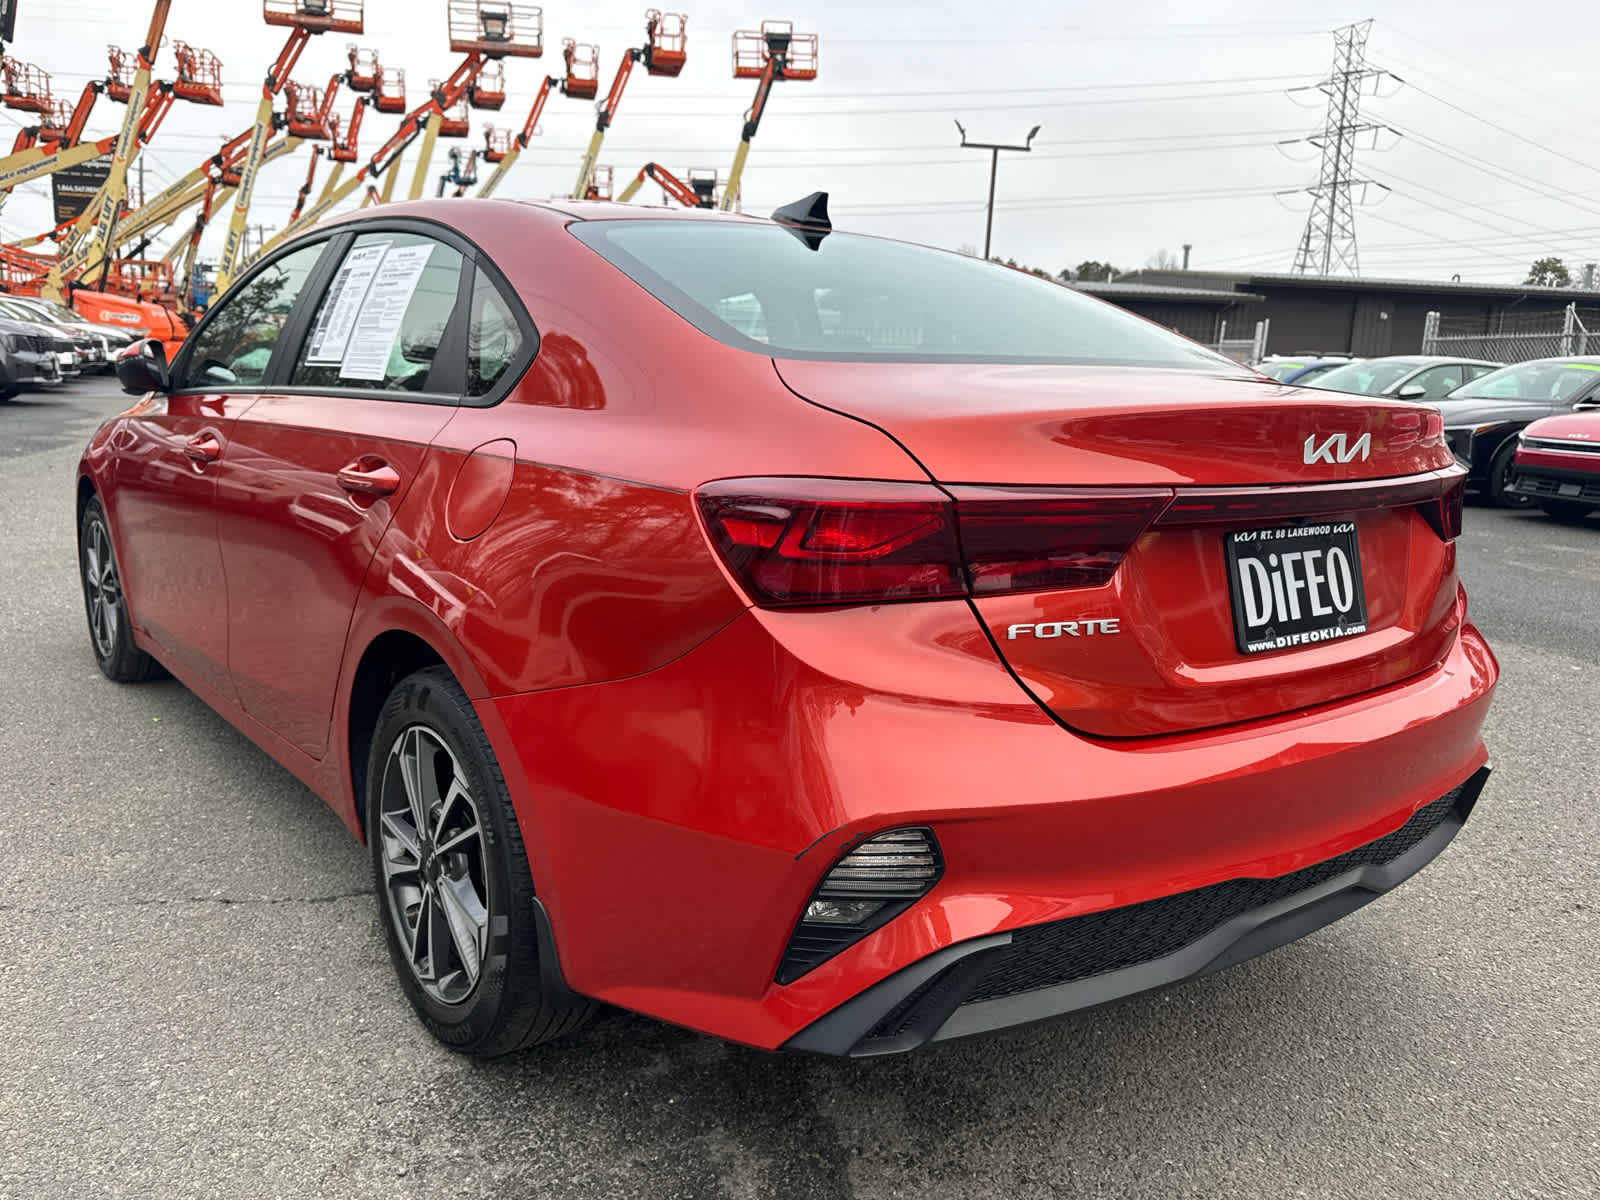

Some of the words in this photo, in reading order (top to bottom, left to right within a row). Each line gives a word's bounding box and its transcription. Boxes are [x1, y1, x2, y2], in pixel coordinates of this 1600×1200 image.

[102, 195, 115, 221] LIFT
[226, 230, 238, 254] LIFT
[1304, 432, 1371, 465] KIA
[1234, 531, 1257, 542] KIA
[1260, 530, 1273, 540] RT.
[1275, 529, 1286, 539] 88
[1287, 525, 1331, 538] LAKEWOOD
[1333, 523, 1355, 534] KIA
[1238, 547, 1353, 627] DiFEO
[1008, 618, 1120, 640] FORTE
[1247, 625, 1367, 652] www.DIFEOKIA.com
